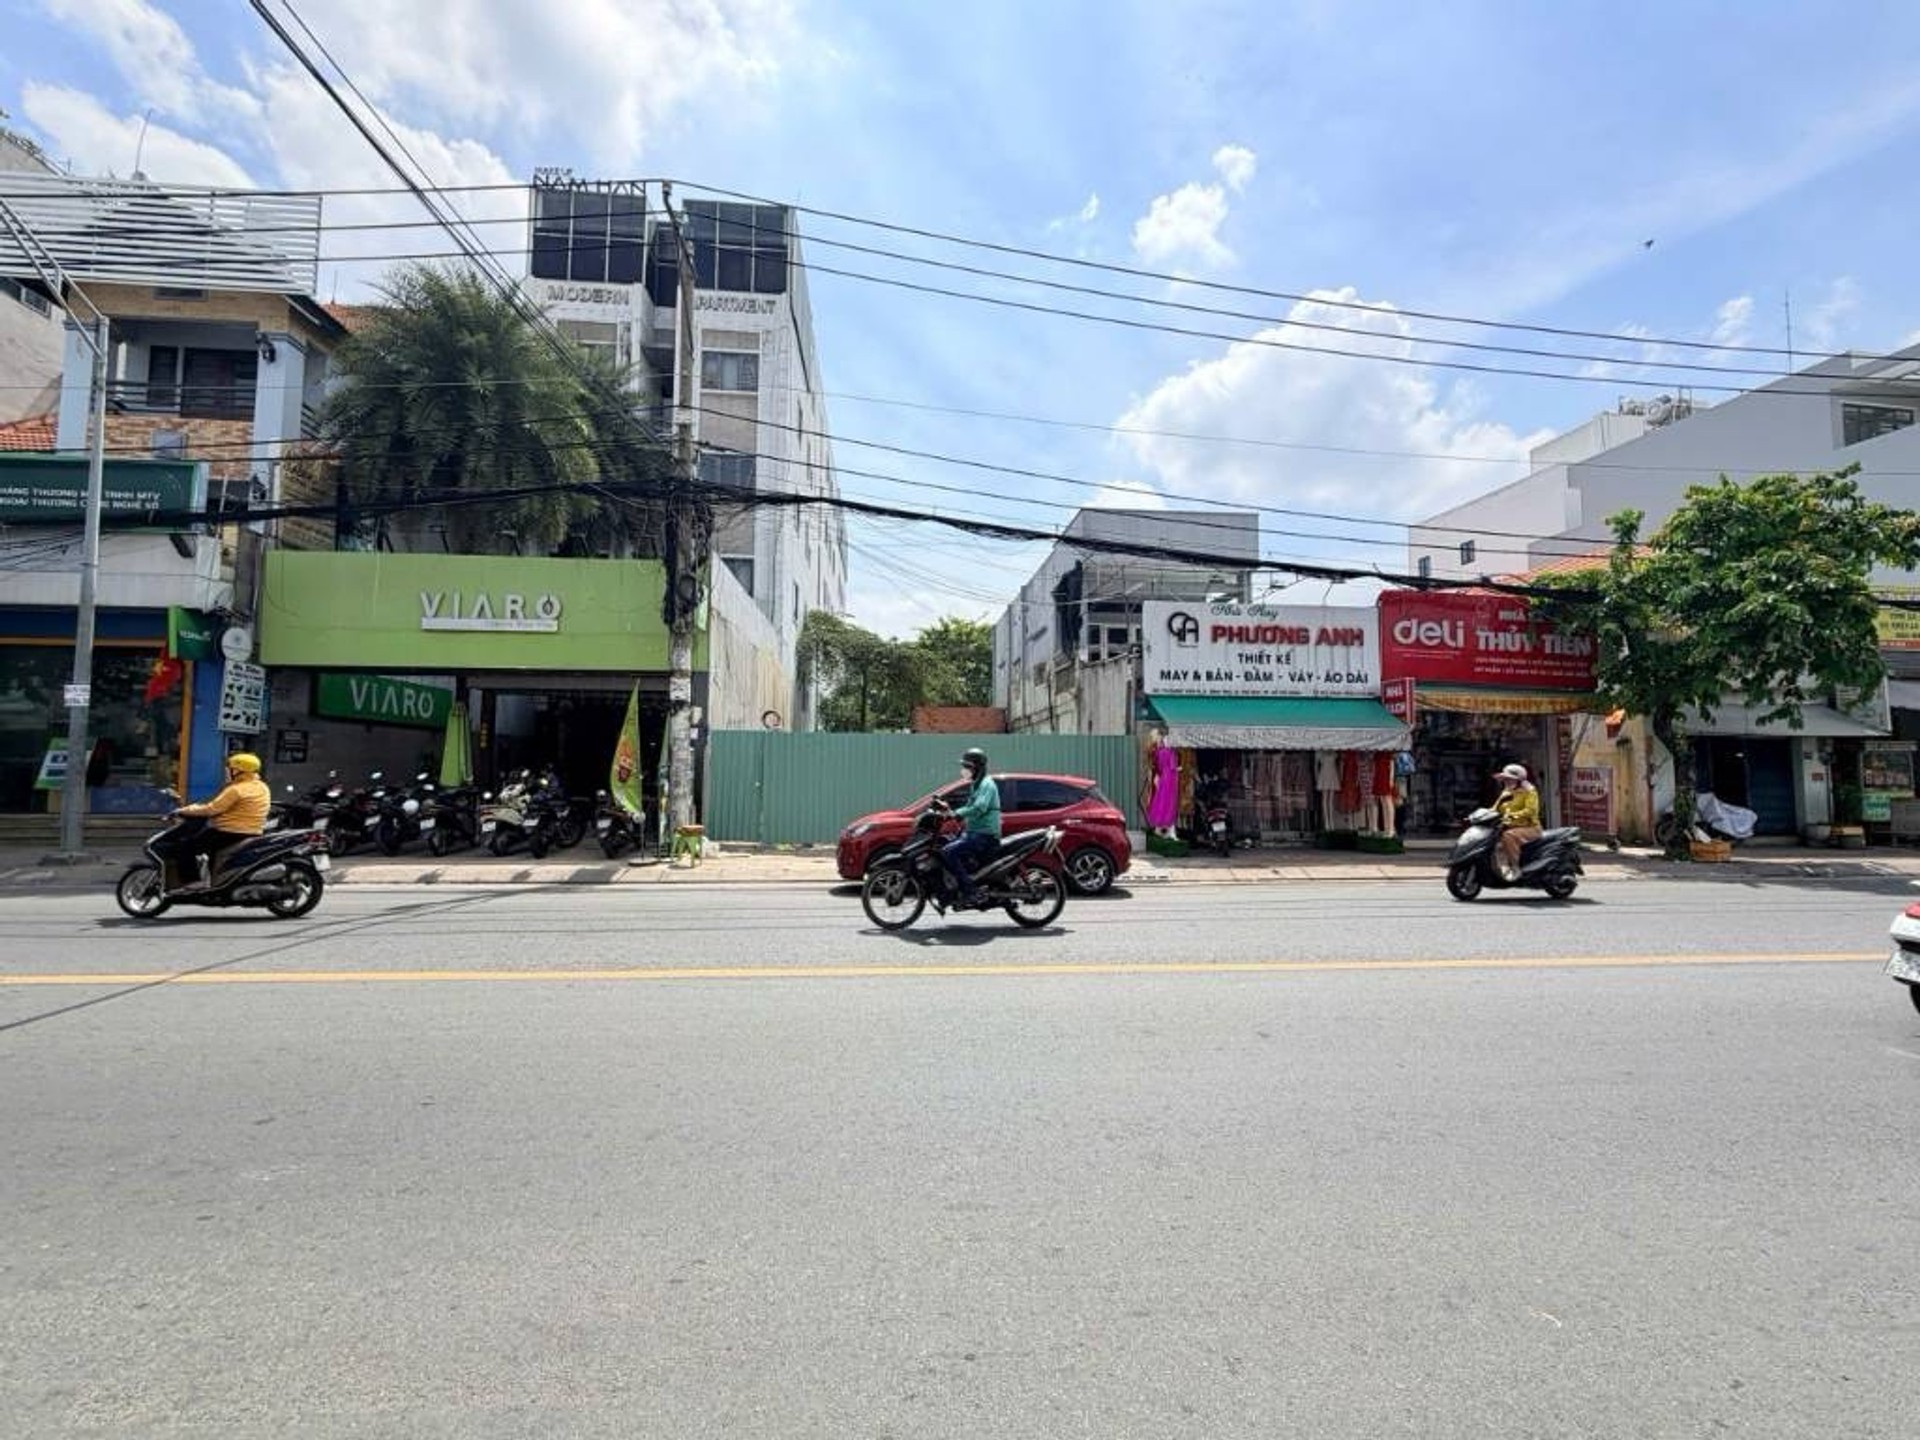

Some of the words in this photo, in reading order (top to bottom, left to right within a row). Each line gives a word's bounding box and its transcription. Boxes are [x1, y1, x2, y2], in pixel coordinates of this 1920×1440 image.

[547, 284, 630, 306] MODERN
[696, 295, 777, 315] PARTMENT
[420, 591, 561, 619] VIARO
[1211, 624, 1309, 645] PHƯƠNG
[1315, 627, 1364, 646] ANH
[1393, 619, 1465, 648] deli
[1238, 649, 1271, 664] THIẾT
[1276, 648, 1292, 664] KẾ
[1160, 670, 1188, 681] MAY
[350, 678, 434, 718] VIARO
